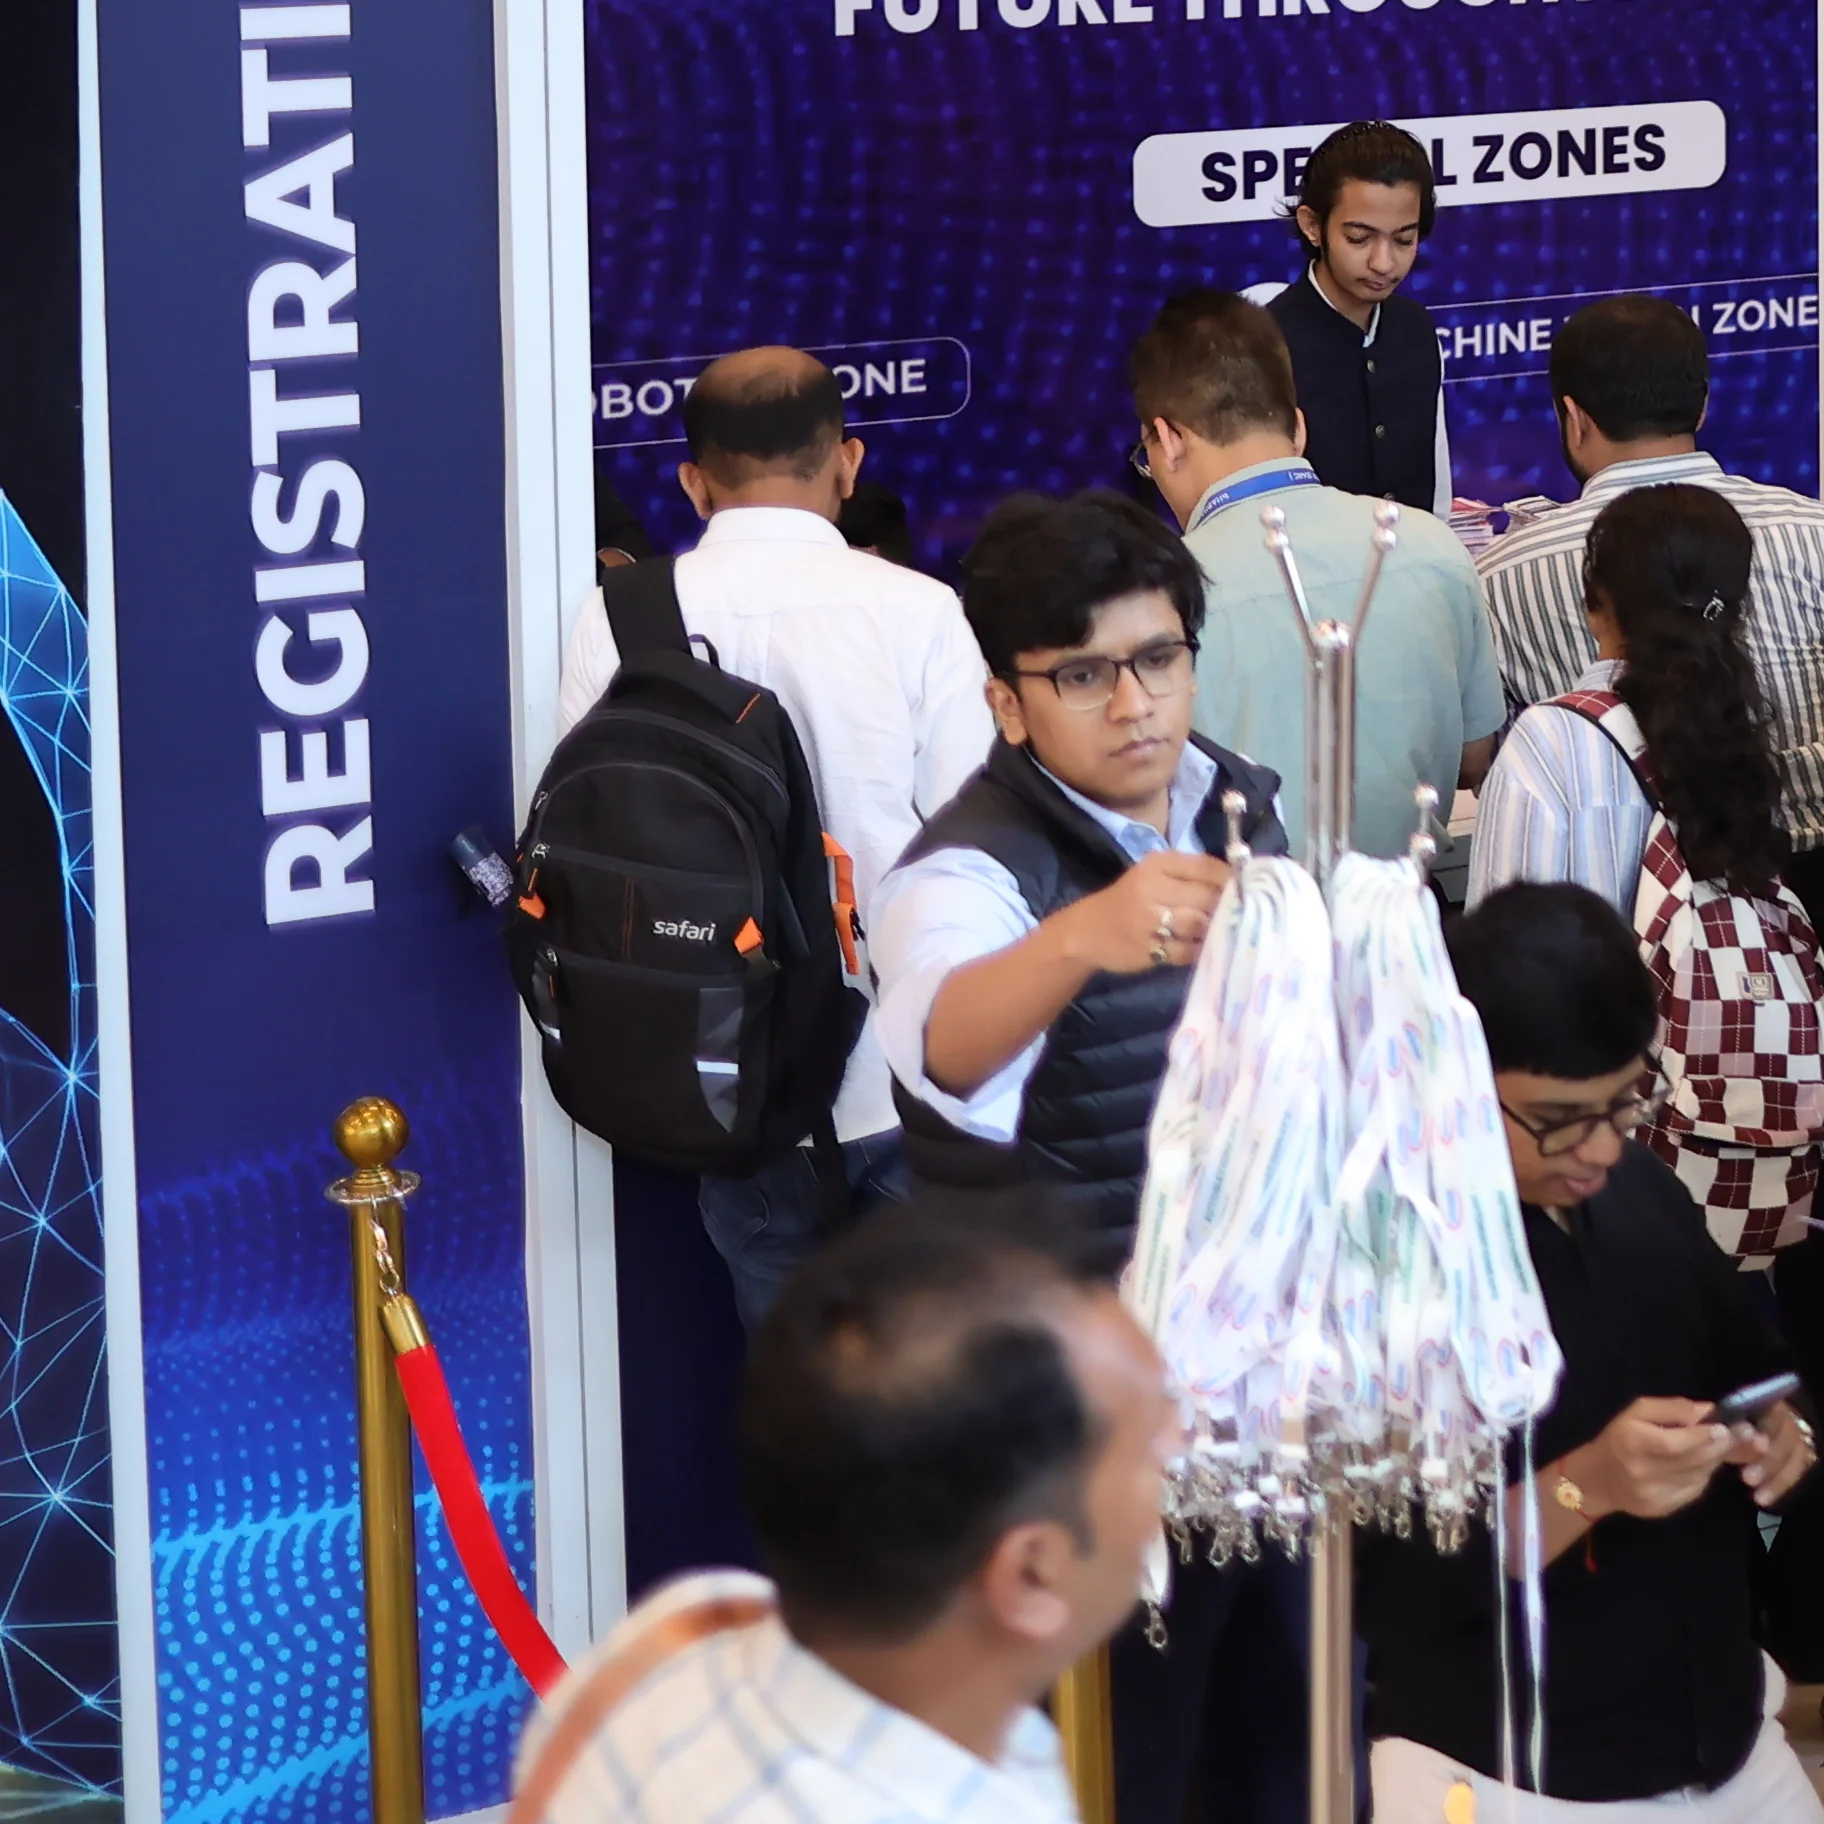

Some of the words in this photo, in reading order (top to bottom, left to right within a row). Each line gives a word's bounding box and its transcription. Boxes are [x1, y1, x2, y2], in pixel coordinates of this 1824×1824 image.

[1471, 123, 1666, 186] ZONES
[1712, 294, 1818, 336] ZONE
[653, 919, 716, 942] safari
